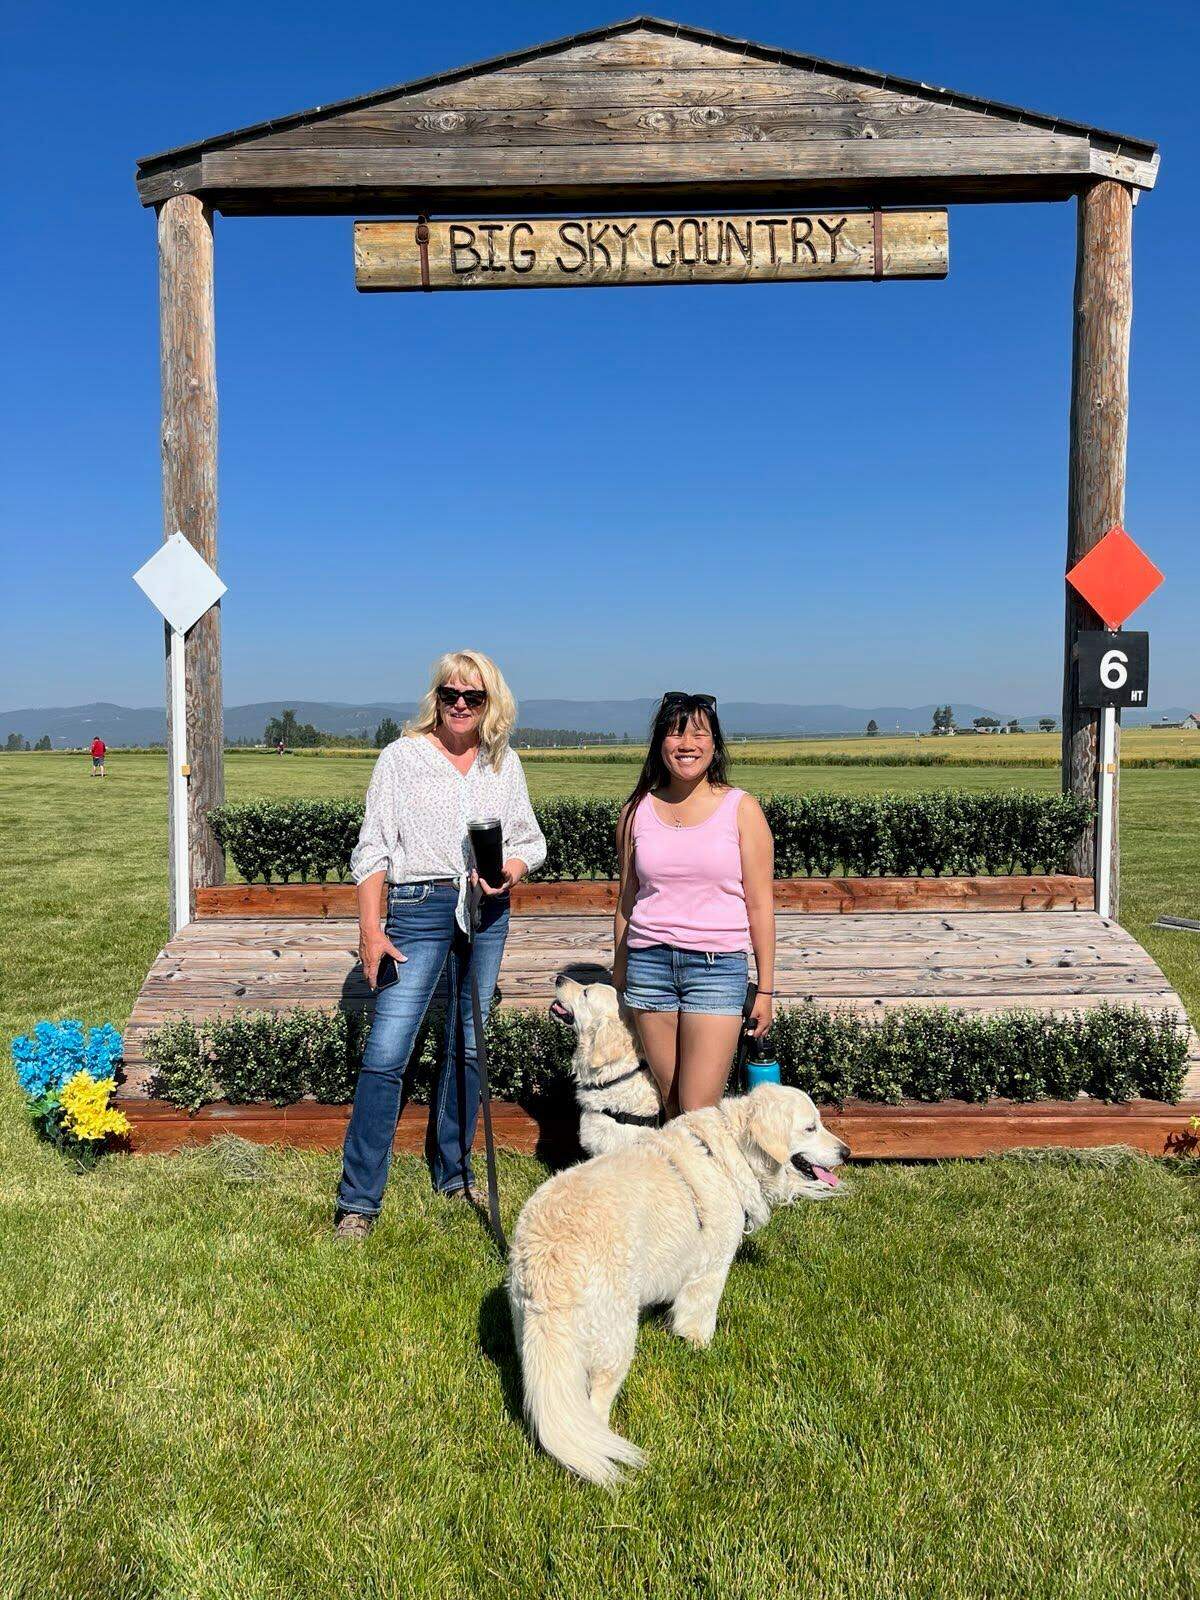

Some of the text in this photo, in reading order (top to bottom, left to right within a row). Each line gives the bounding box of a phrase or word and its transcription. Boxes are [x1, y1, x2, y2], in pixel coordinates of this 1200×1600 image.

[450, 216, 848, 273] BIG SKY COUNTRY
[1100, 649, 1129, 689] 6
[1130, 690, 1144, 701] HT
